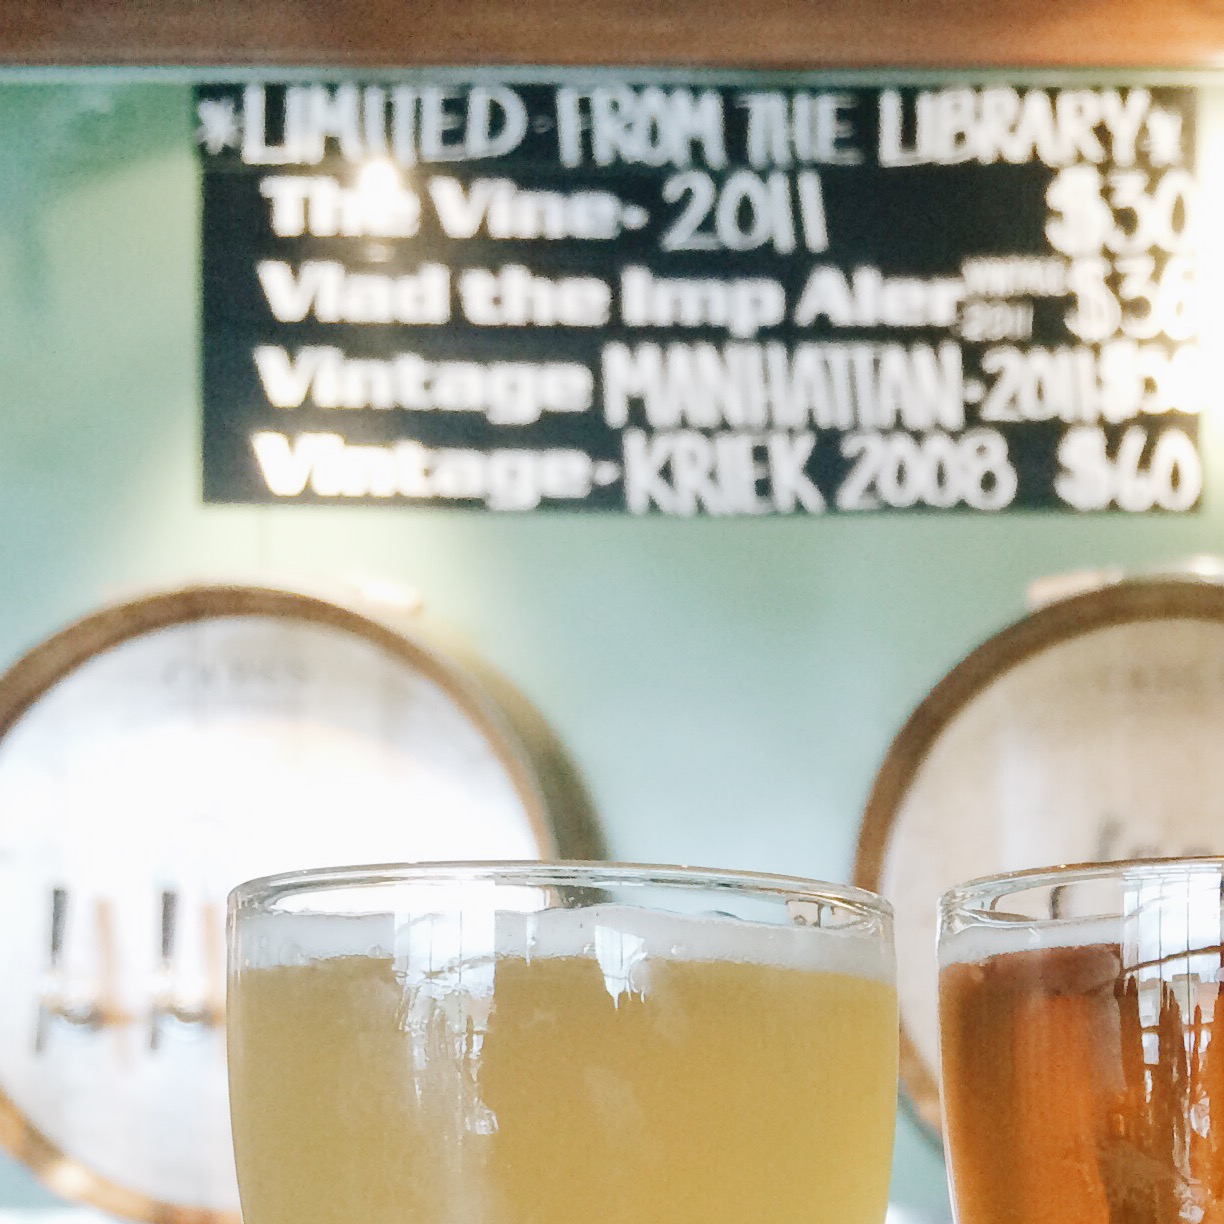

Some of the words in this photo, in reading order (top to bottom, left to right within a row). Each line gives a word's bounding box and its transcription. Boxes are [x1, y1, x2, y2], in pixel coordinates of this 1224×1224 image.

[740, 90, 863, 166] THE
[660, 171, 829, 252] 2011
[256, 260, 452, 324] Vlad
[458, 264, 612, 327] the
[621, 266, 788, 338] Imp
[252, 344, 594, 425] Vintage
[622, 427, 829, 515] KRIEK
[837, 428, 1018, 512] 2008
